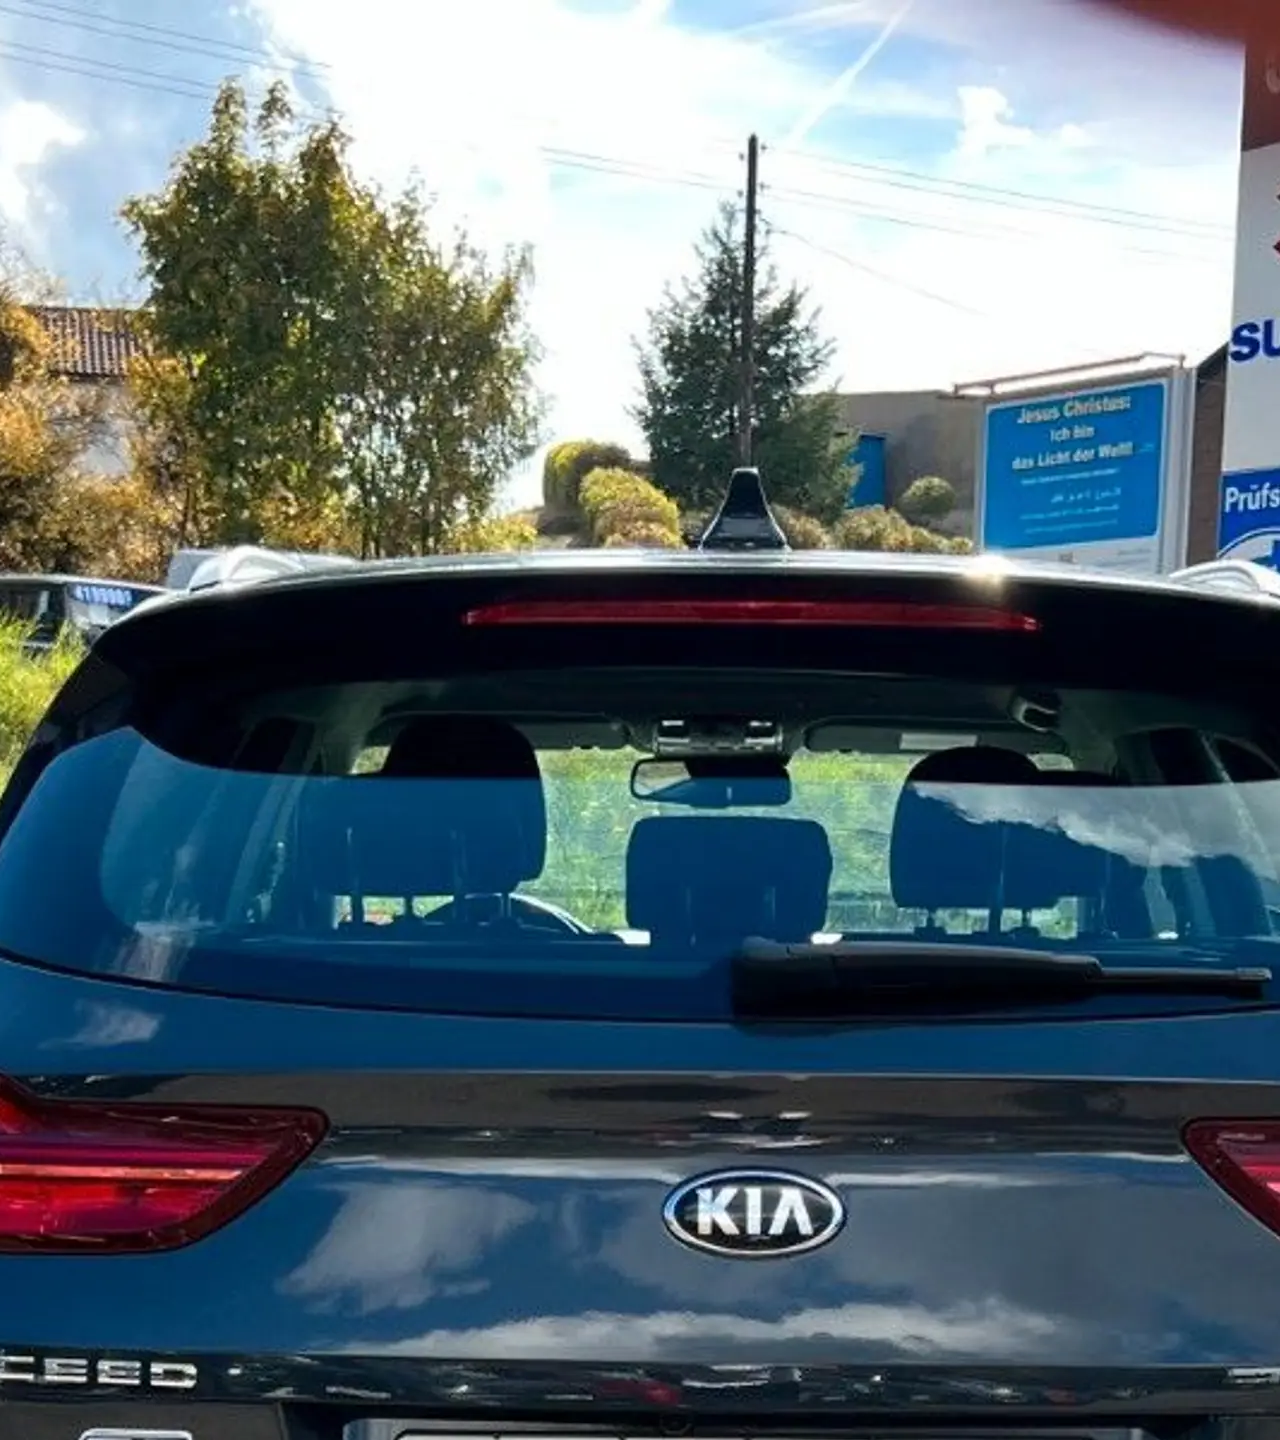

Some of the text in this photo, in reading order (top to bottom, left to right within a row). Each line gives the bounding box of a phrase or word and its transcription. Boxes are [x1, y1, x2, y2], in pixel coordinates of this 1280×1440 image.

[1017, 407, 1060, 424] Jesus
[1050, 425, 1095, 442] Ich bin
[1012, 457, 1035, 470] das
[1037, 451, 1070, 467] Licht
[1073, 448, 1095, 462] der
[695, 1186, 814, 1236] KIA
